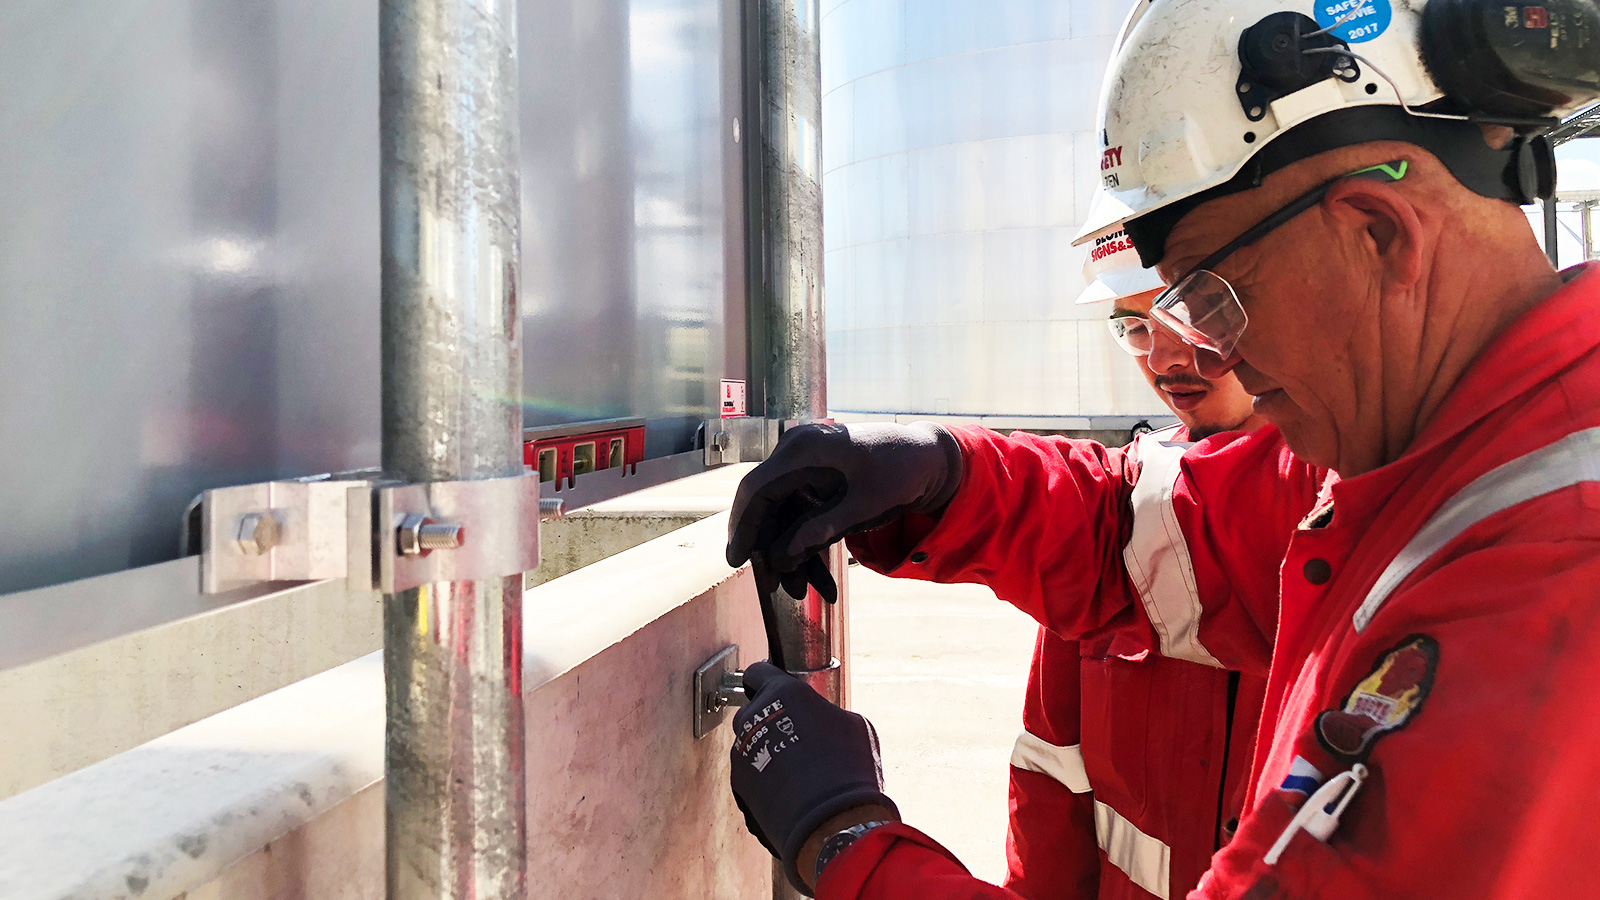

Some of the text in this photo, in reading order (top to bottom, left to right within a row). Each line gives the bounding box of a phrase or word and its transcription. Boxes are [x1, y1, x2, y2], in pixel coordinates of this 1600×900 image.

[1325, 0, 1373, 15] SAFE
[1347, 22, 1378, 40] 2017
[742, 725, 769, 757] 14-695
